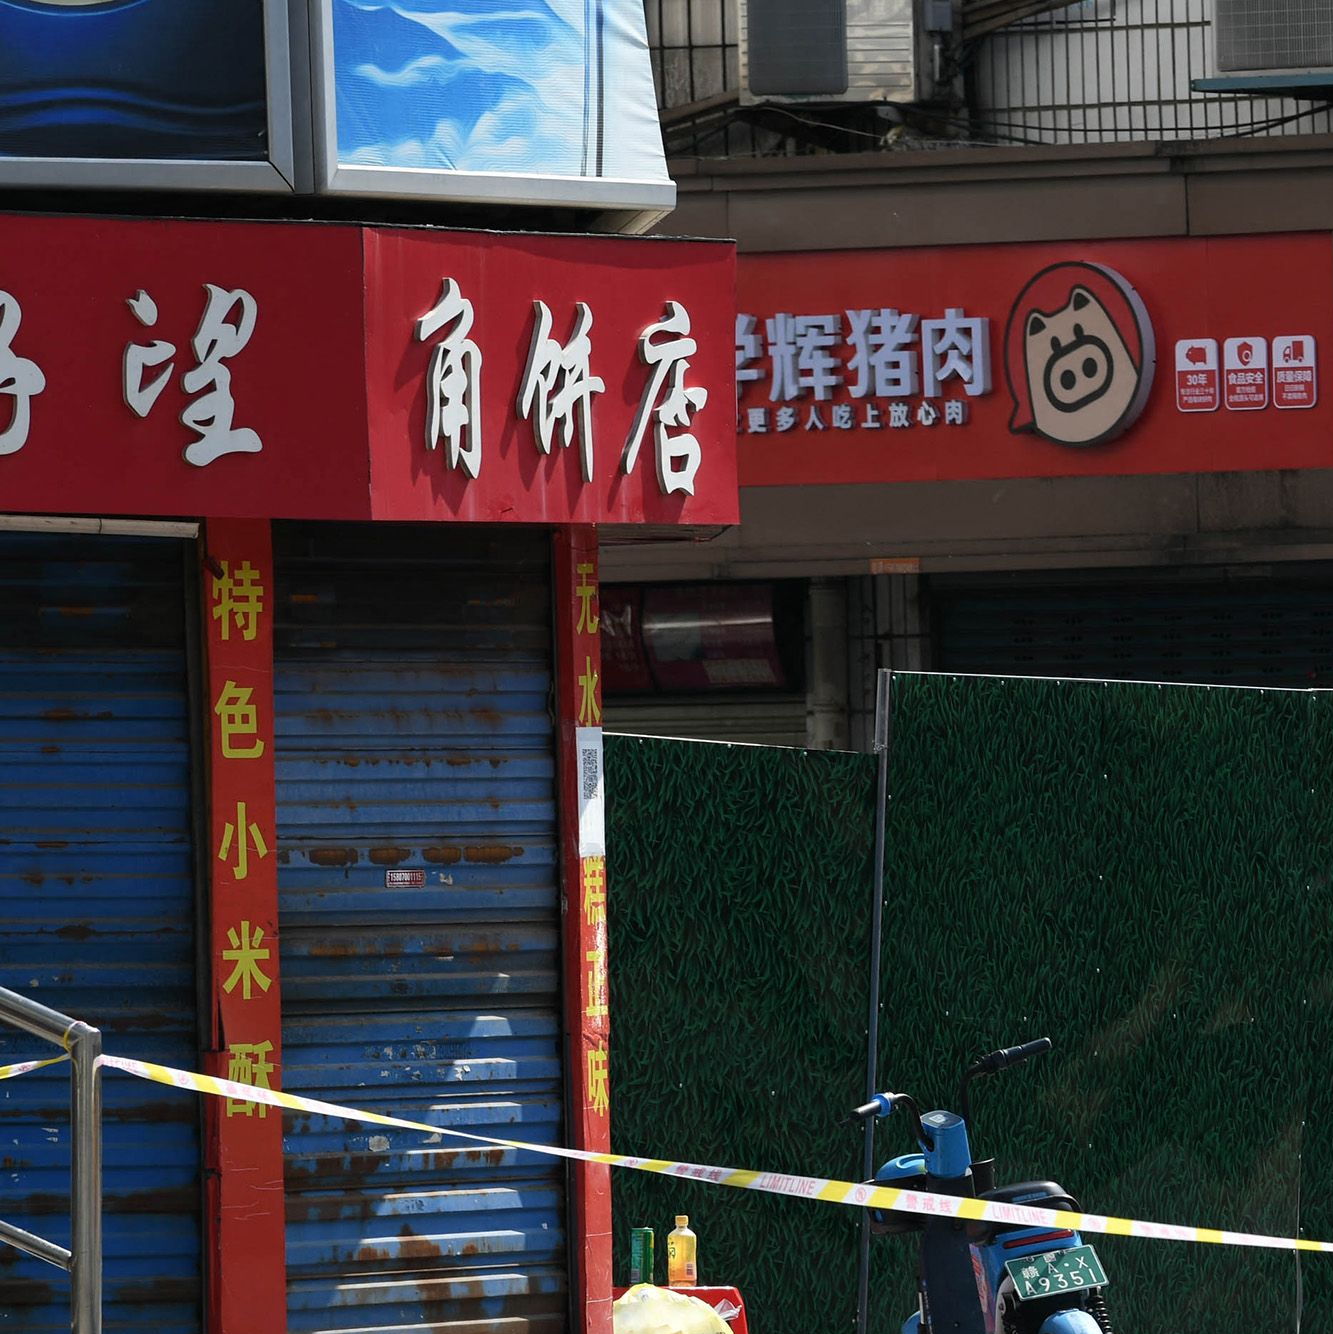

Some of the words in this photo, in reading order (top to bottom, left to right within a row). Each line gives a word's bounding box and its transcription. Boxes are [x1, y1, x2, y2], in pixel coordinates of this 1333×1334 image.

[414, 277, 708, 496] 角饼店
[737, 400, 969, 434] 更多人吃上放心肉
[212, 560, 276, 1118] 特色小米酥
[759, 1173, 817, 1196] LIMITLINE
[905, 1193, 954, 1213] 警戒线
[992, 1205, 1050, 1226] LIMITLINE
[1024, 1268, 1098, 1296] A9351
